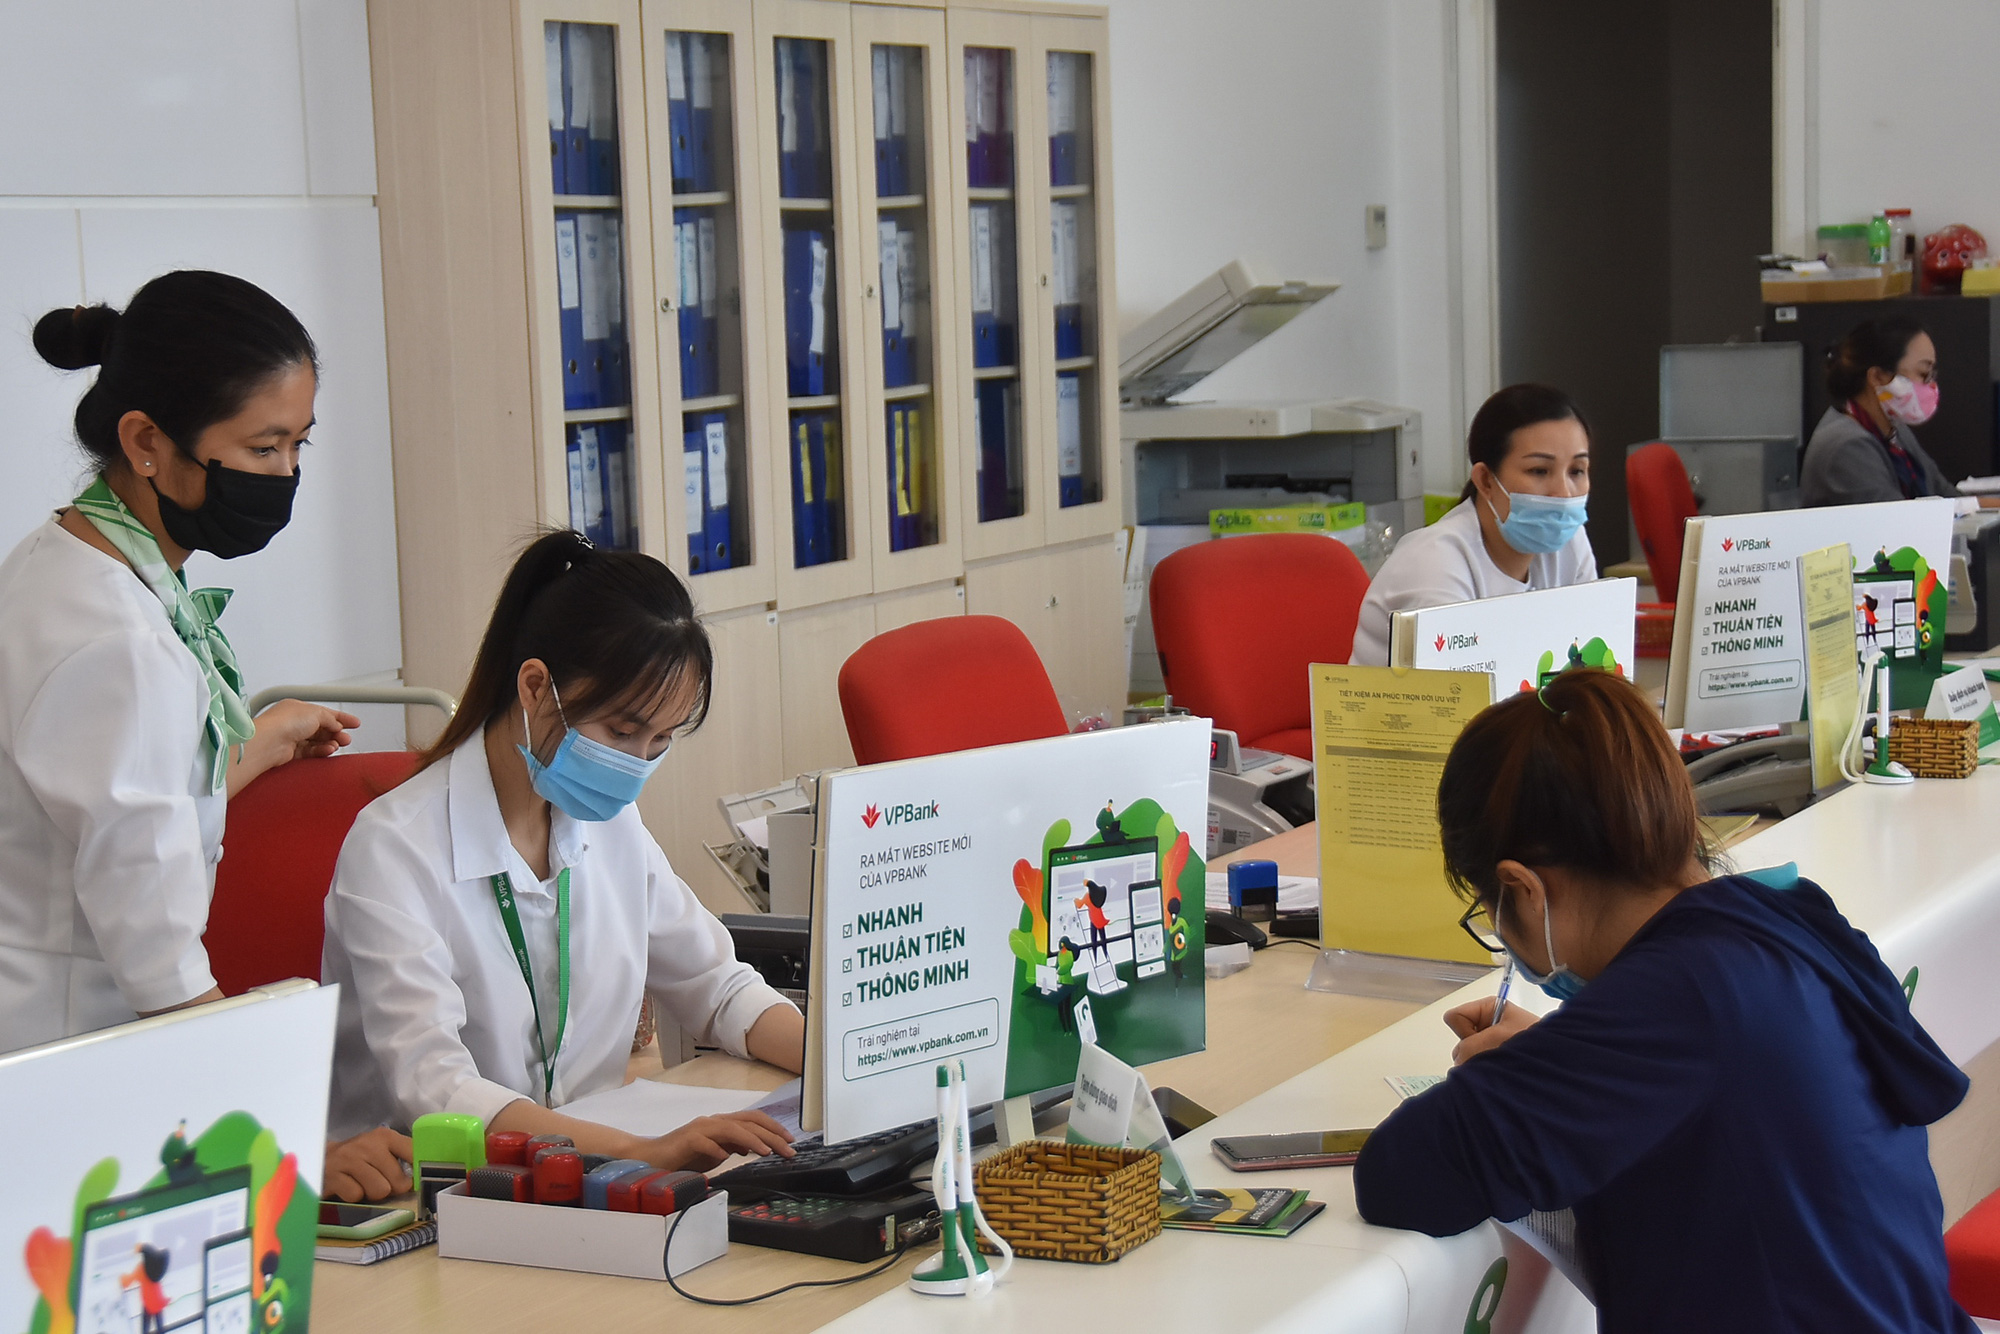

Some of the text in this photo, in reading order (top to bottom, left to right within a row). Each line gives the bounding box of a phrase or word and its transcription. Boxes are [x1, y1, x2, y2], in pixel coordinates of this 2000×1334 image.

[1735, 537, 1771, 551] VPBank
[1719, 566, 1728, 575] RA
[1745, 561, 1777, 573] WEBSITE
[1733, 575, 1761, 587] VPBANK
[1714, 598, 1757, 614] NHANH
[1712, 614, 1783, 634] THUẬN TIỆN
[1447, 632, 1479, 650] VPBank
[1711, 635, 1784, 654] THÔNG MINH
[1708, 676, 1794, 692] https://www.vpbank.com.vn
[884, 799, 939, 826] VPBank
[860, 853, 876, 869] RA
[902, 839, 950, 861] WEBSITE
[859, 863, 928, 890] CỦA VPBANK
[857, 901, 923, 935] NHANH
[856, 925, 966, 969] THUẬN TIỆN
[856, 958, 969, 1003] THÔNG MINH
[857, 1023, 921, 1049] Trải nghiệm tại
[857, 1026, 989, 1067] https://www.vpbank.com.vn
